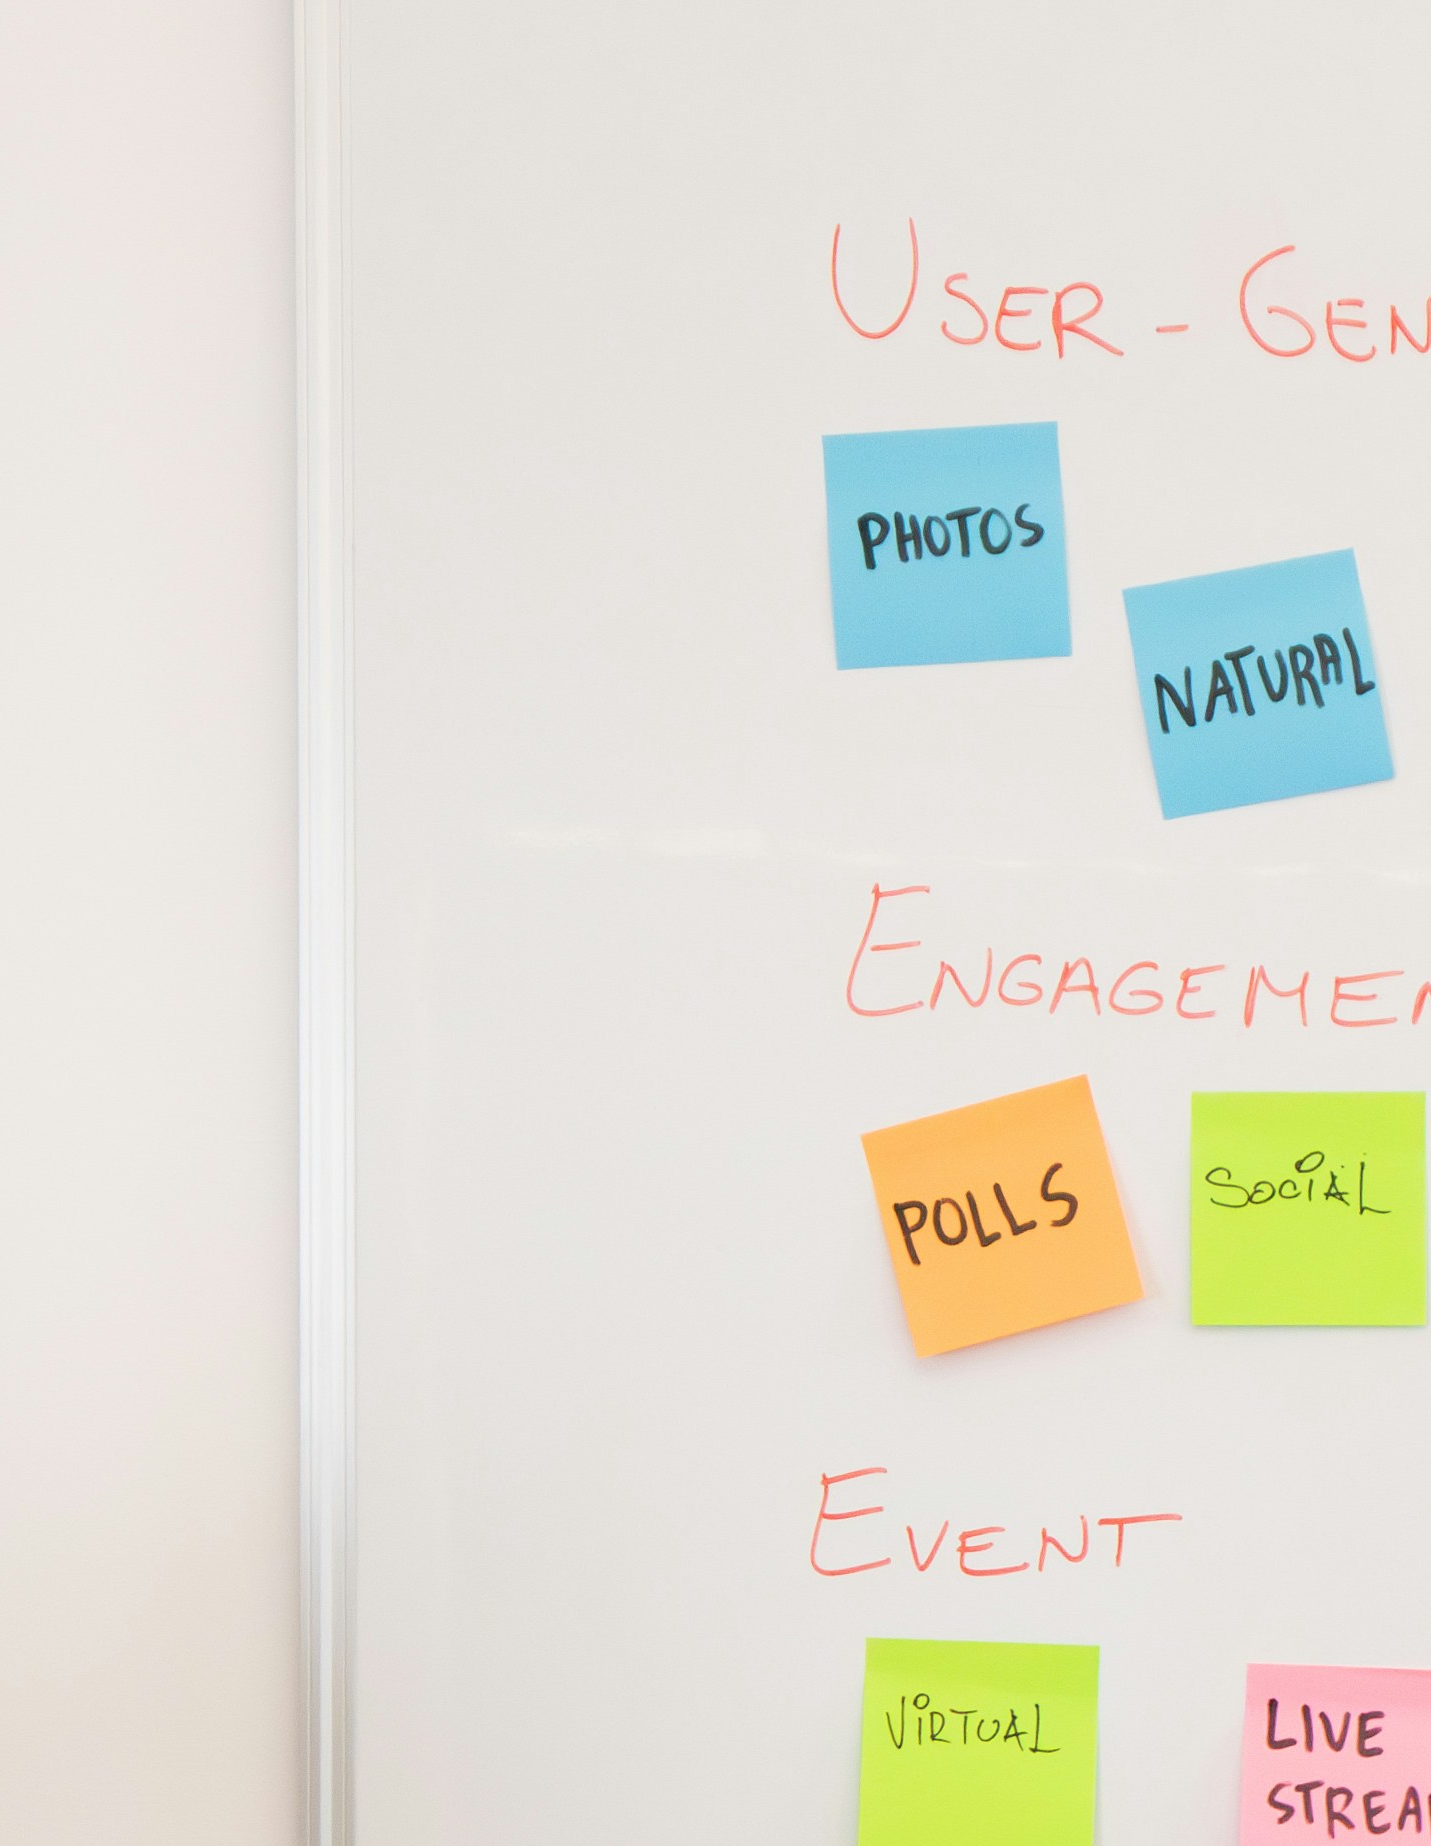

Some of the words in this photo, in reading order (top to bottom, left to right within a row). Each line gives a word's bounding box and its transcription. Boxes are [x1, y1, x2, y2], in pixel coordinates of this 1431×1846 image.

[831, 216, 1124, 359] USER
[856, 502, 1045, 571] PHOTOS
[1153, 627, 1376, 735] NATURAL
[892, 1160, 1081, 1266] POLLS
[808, 1465, 1184, 1578] EVENT
[1265, 1697, 1387, 1760] LIVE
